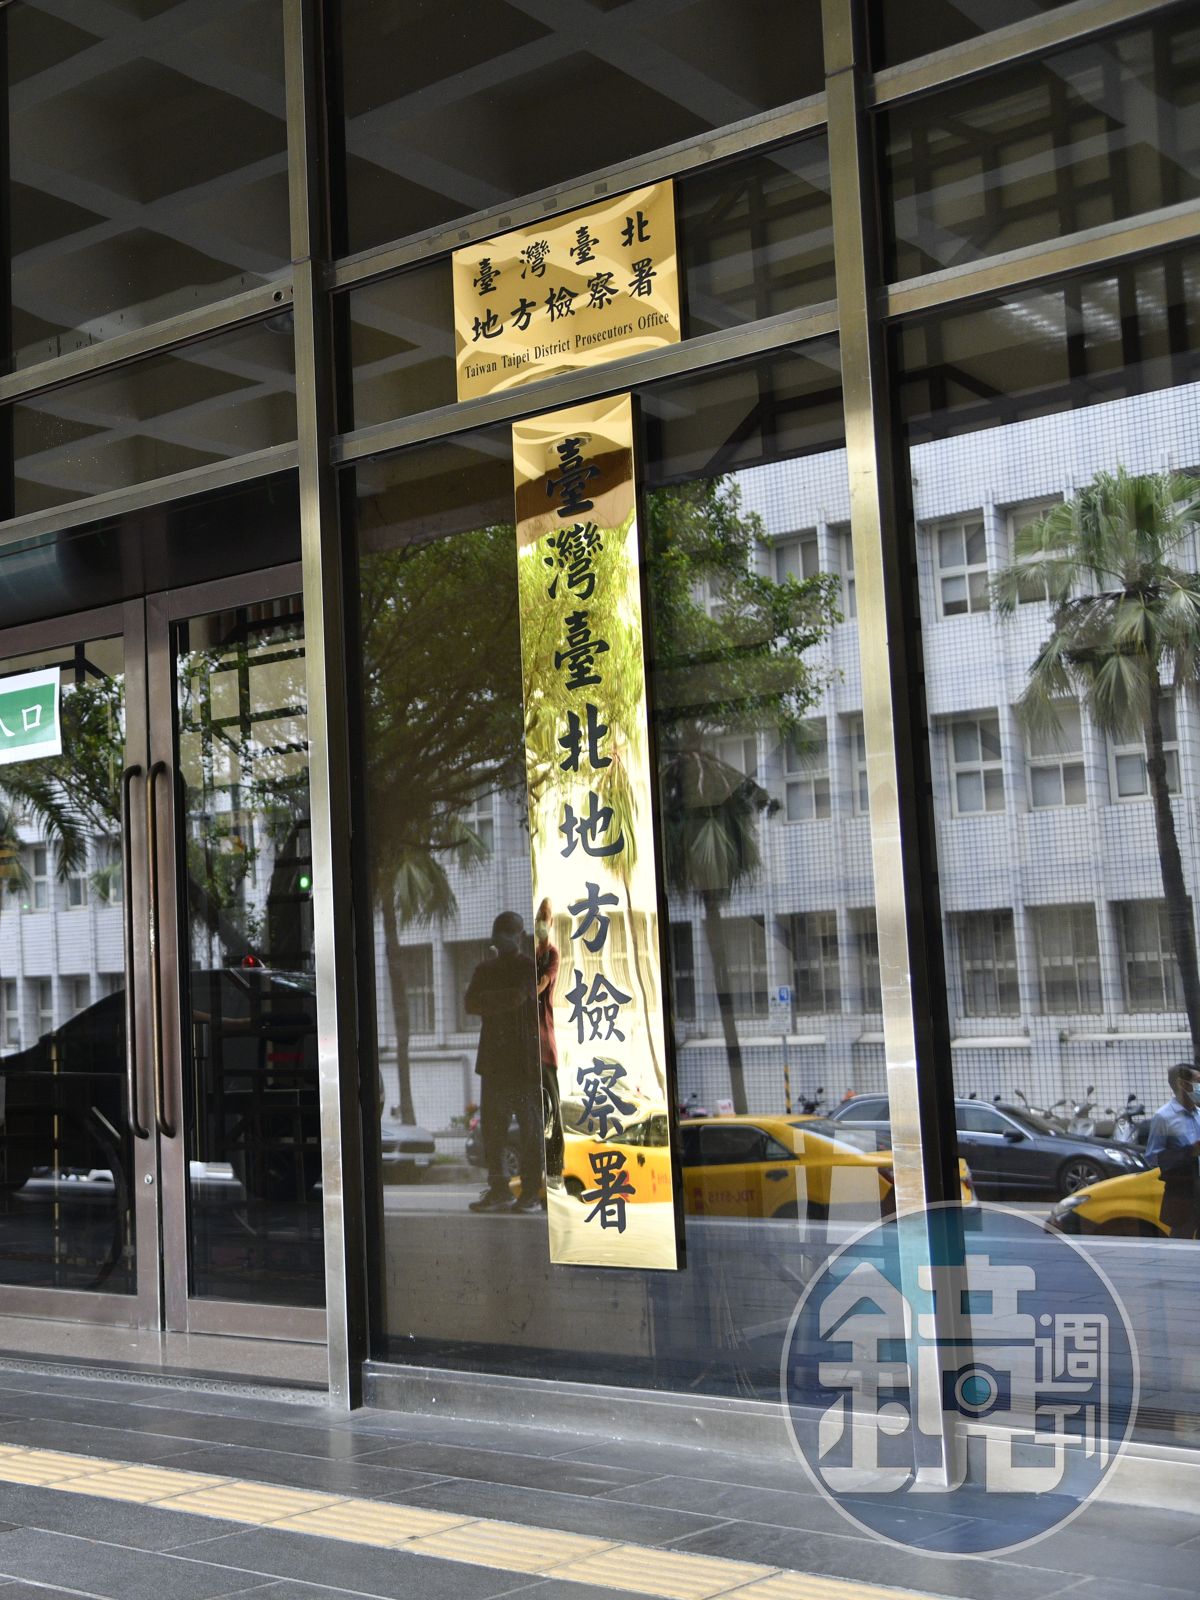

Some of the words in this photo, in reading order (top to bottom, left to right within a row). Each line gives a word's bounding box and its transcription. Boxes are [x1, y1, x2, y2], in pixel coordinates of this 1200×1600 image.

[473, 211, 651, 297] 臺灣臺北
[471, 257, 657, 342] 地方檢察署
[465, 361, 497, 379] Taiwan
[501, 349, 530, 369] Taipei
[534, 338, 570, 360] District
[575, 322, 633, 348] Prosecutors
[638, 311, 669, 331] Office
[544, 437, 638, 1235] 臺灣臺北地方檢察署
